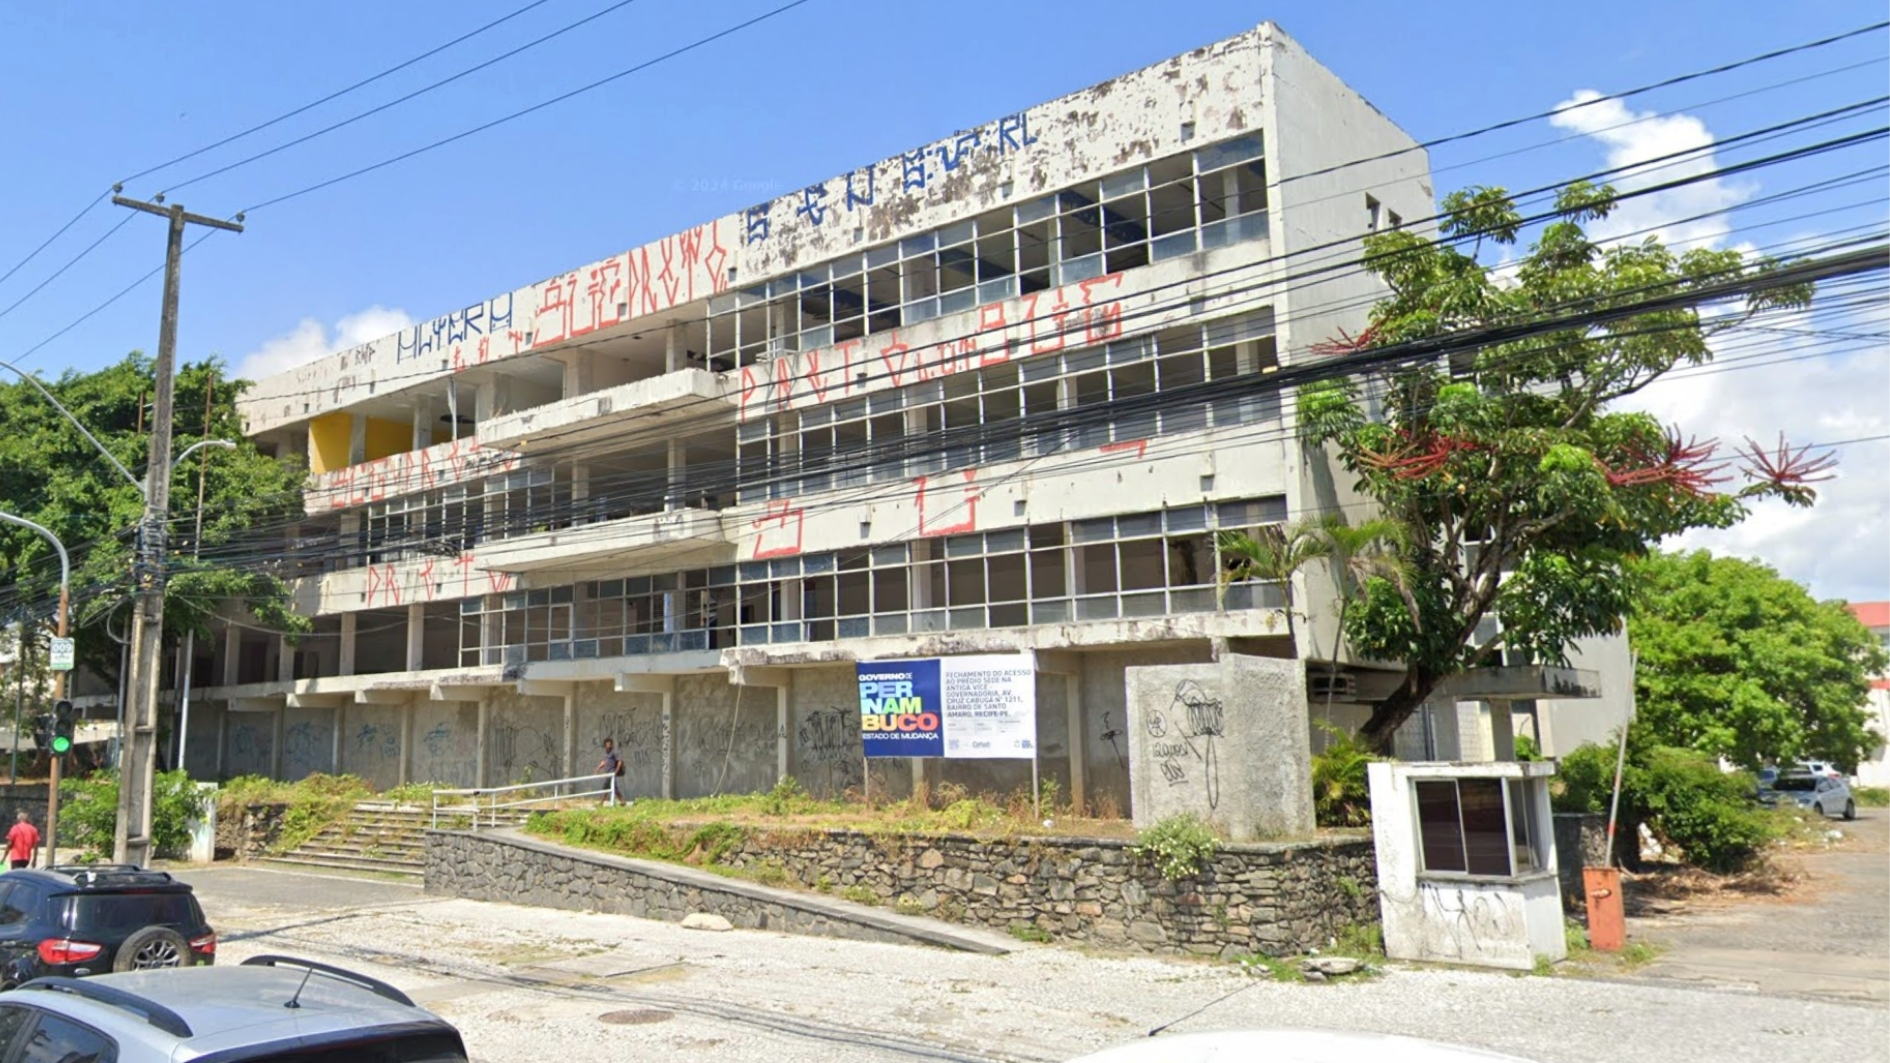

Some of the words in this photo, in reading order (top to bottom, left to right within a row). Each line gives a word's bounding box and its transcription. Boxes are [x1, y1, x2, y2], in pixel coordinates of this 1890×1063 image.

[52, 643, 73, 652] 009
[859, 672, 905, 681] GOVERNO
[946, 670, 991, 678] FECHAMENTO
[859, 681, 914, 698] PER
[861, 697, 922, 715] NAM
[984, 702, 1007, 710] SANTO
[862, 713, 939, 732] BUCO
[862, 732, 890, 740] ESTADO
[890, 732, 900, 740] DE
[901, 732, 939, 741] MUDANÇA
